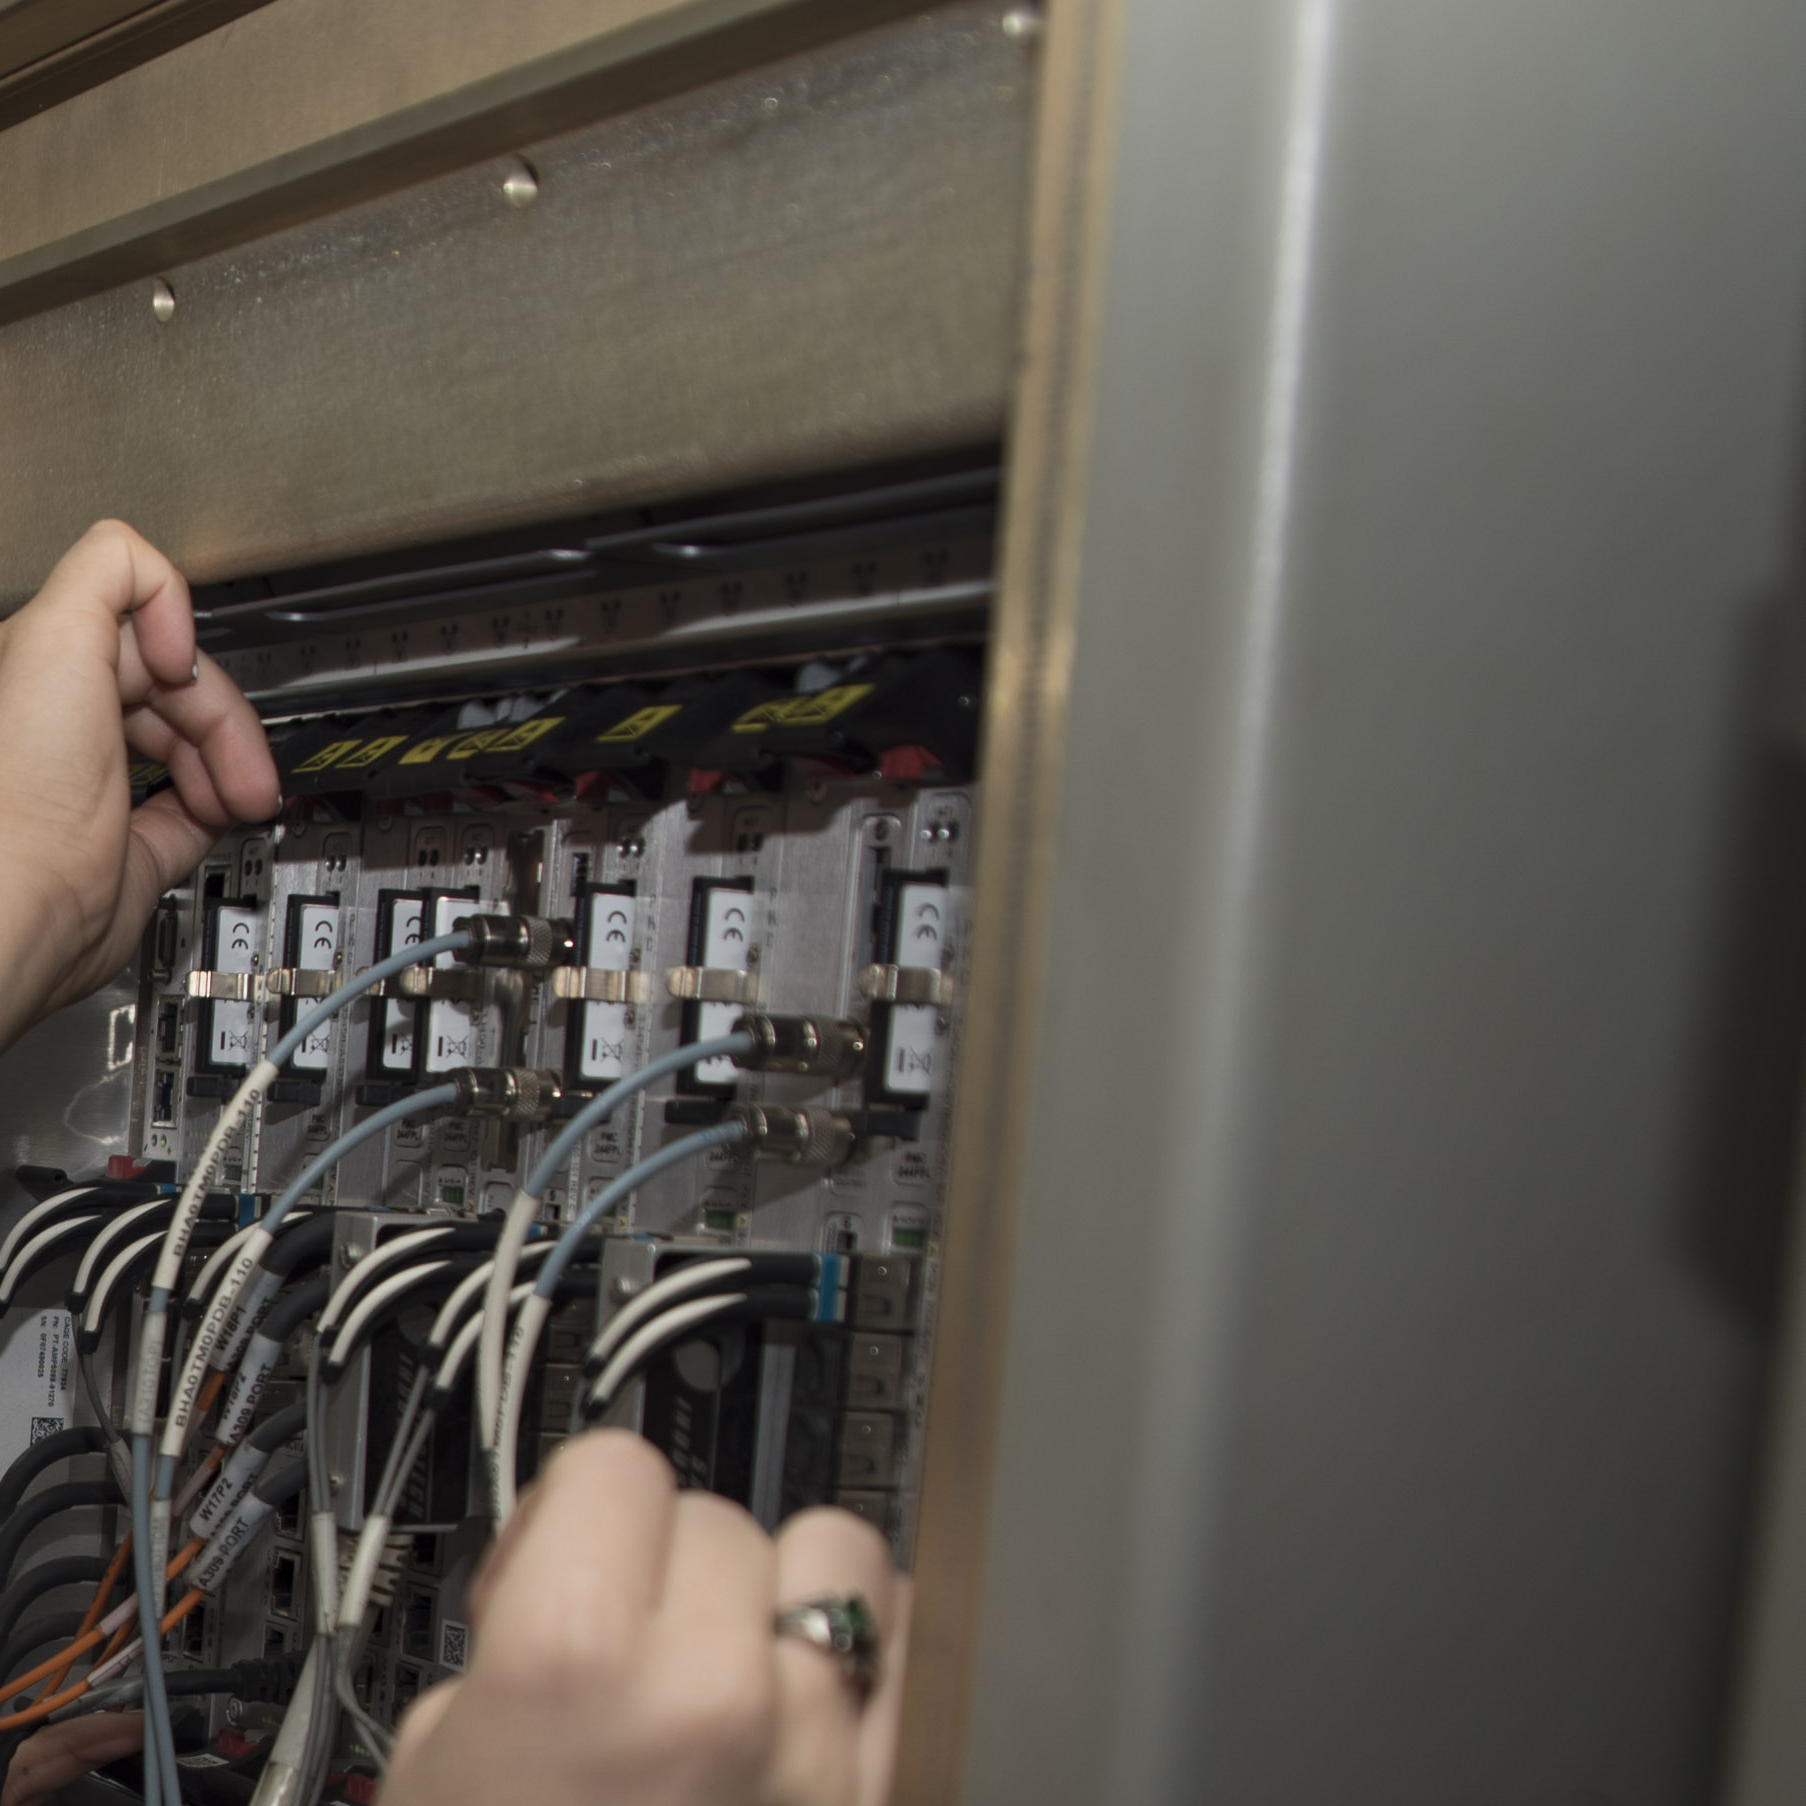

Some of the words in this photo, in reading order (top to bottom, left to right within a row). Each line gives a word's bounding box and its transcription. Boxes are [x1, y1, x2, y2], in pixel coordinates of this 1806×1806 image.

[62, 1316, 71, 1339] CAGE
[215, 1304, 247, 1351] W18P1
[246, 1363, 273, 1405] PORT
[199, 1477, 234, 1522] W17P2
[218, 1516, 250, 1556] PORT
